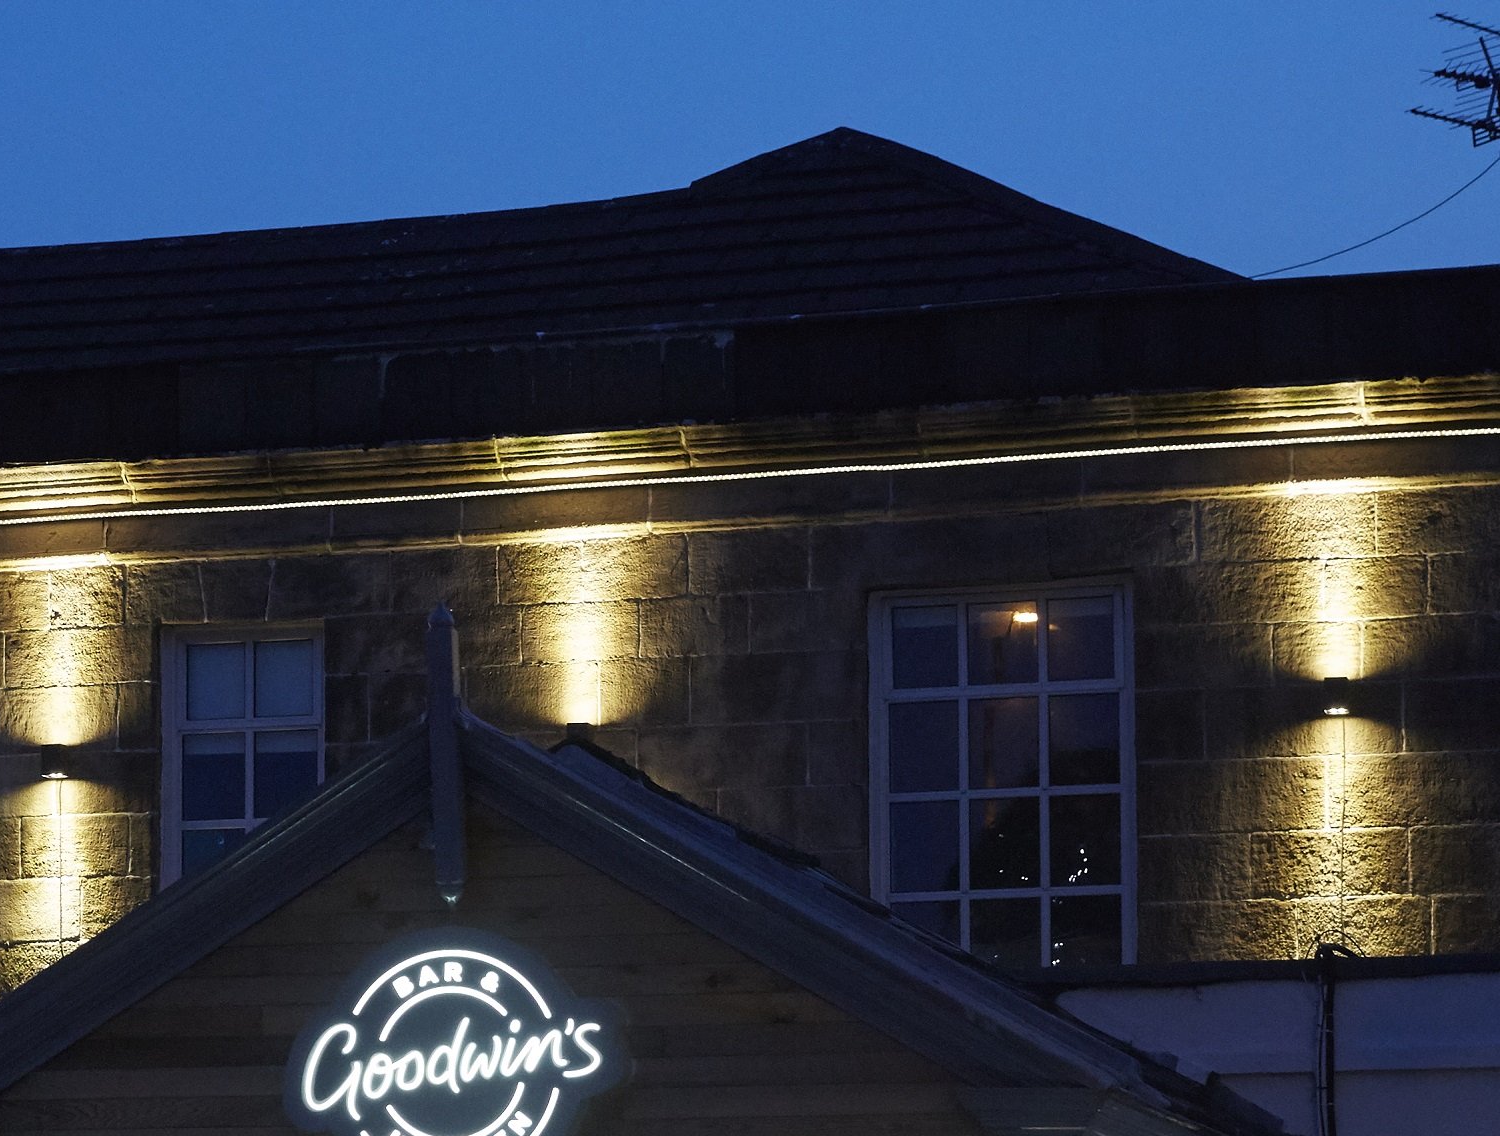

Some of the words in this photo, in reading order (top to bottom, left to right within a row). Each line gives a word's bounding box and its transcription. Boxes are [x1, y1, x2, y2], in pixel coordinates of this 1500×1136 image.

[392, 961, 463, 998] BAR
[480, 971, 499, 993] &
[302, 1017, 603, 1121] Goodwin's
